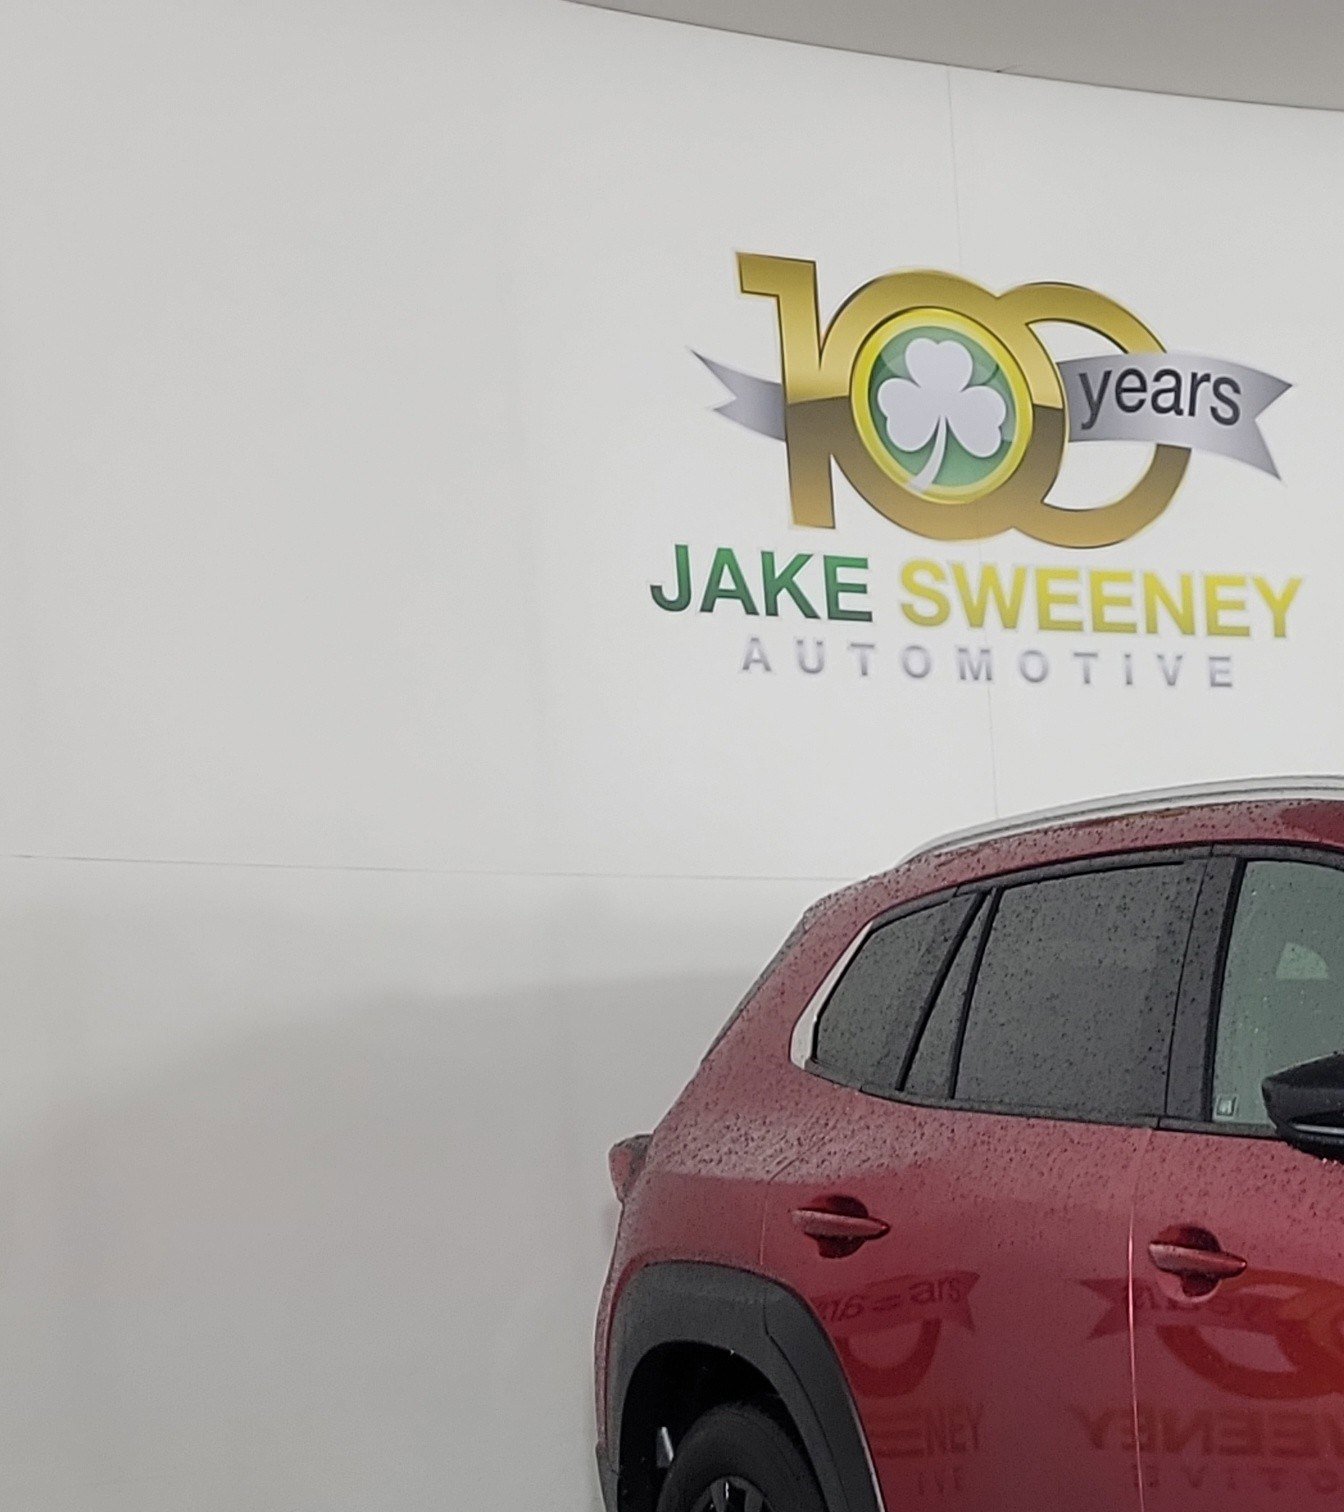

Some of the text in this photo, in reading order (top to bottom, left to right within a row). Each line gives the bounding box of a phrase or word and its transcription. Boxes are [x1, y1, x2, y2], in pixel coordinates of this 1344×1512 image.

[735, 252, 1243, 550] 100 years
[649, 543, 1304, 638] JAKE SWEENEY
[740, 636, 1234, 689] AUTOMOTIVE
